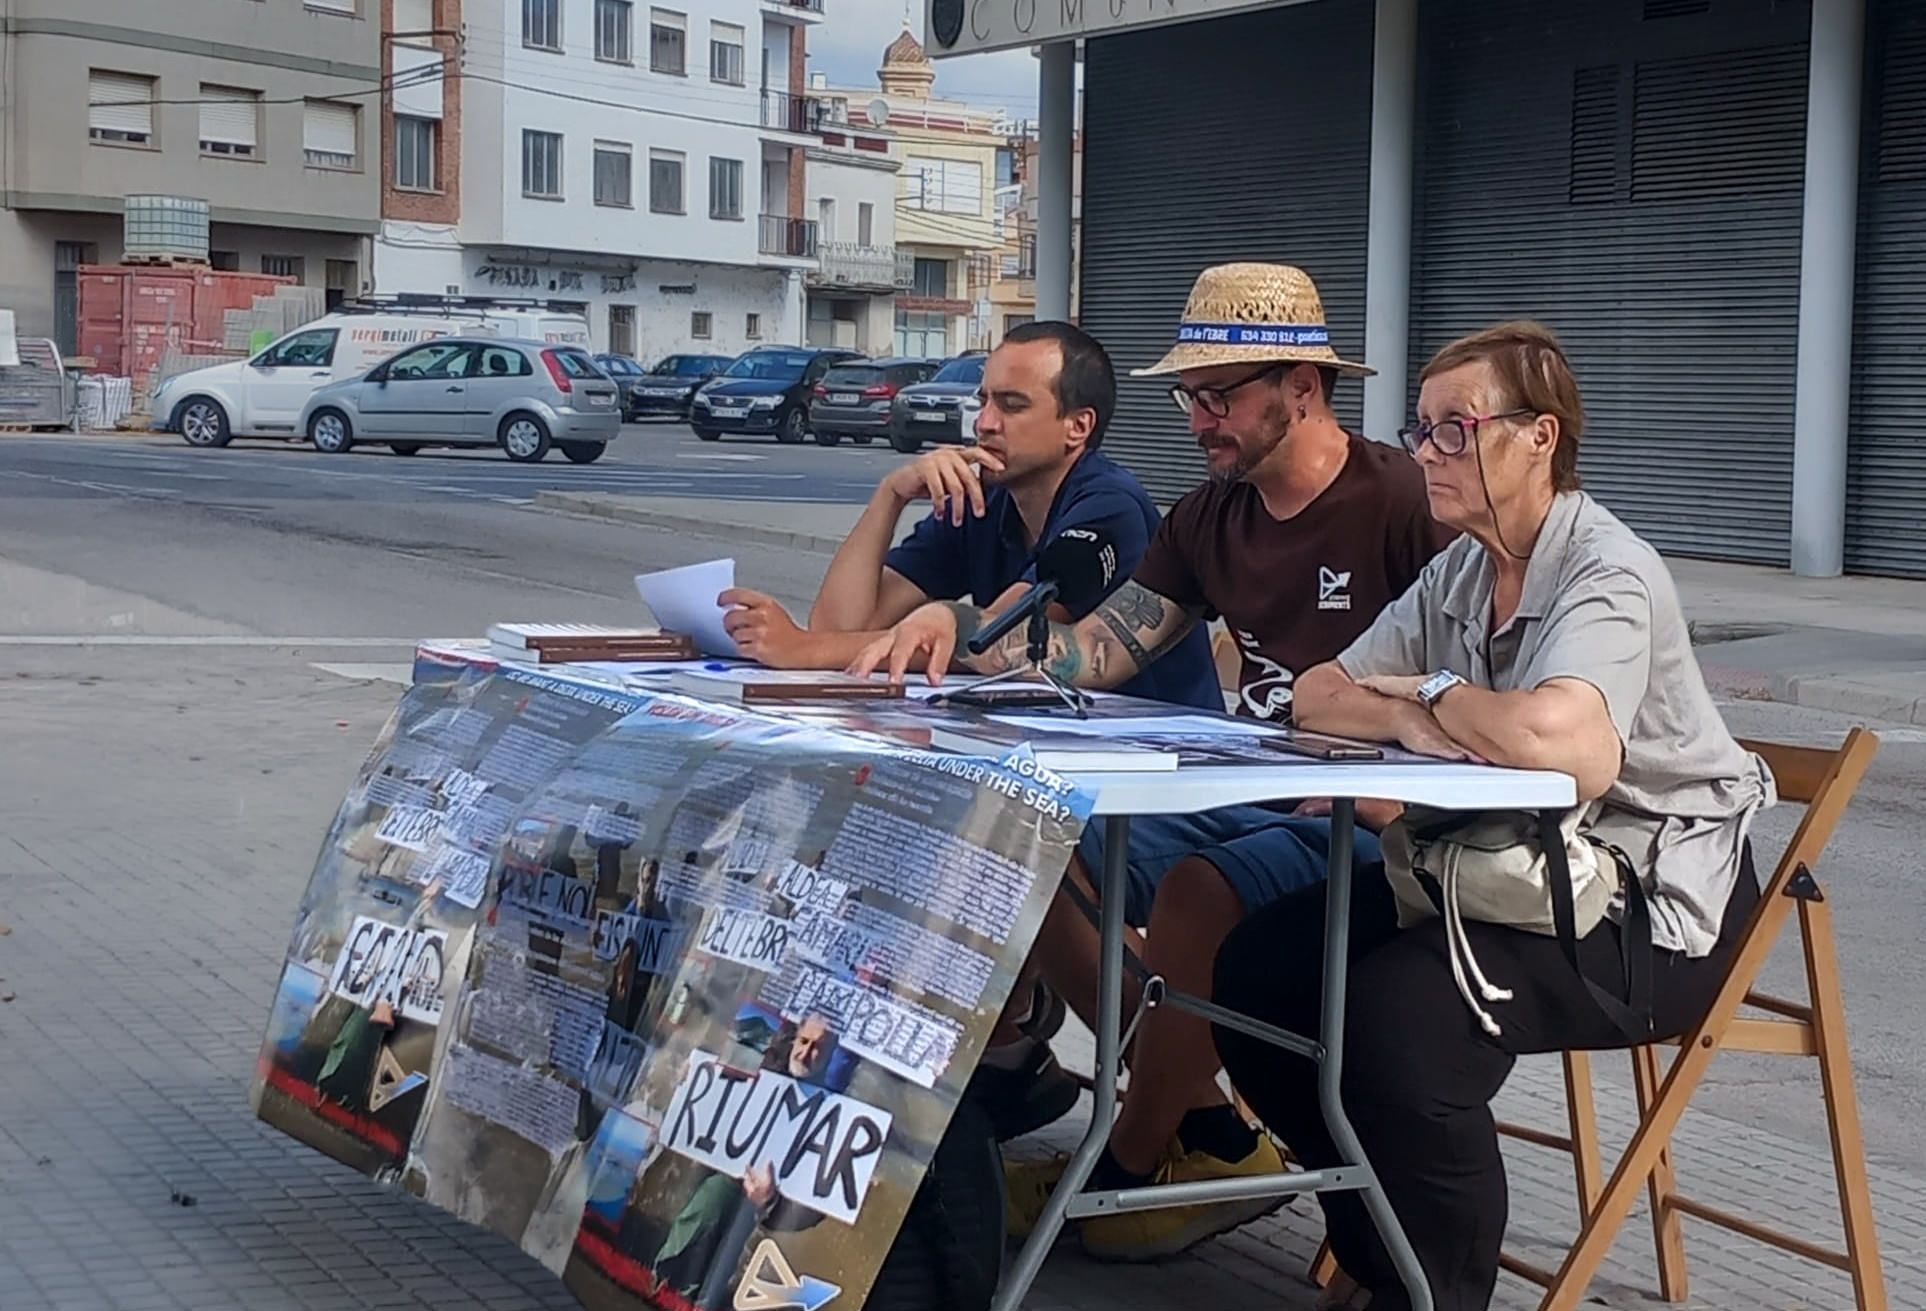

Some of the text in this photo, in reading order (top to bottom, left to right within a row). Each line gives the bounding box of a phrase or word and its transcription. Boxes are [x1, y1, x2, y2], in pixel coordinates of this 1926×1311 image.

[938, 756, 985, 783] UNDER
[986, 771, 1022, 799] THE
[1023, 788, 1072, 824] SEA?
[668, 1061, 882, 1211] RIUMAR
